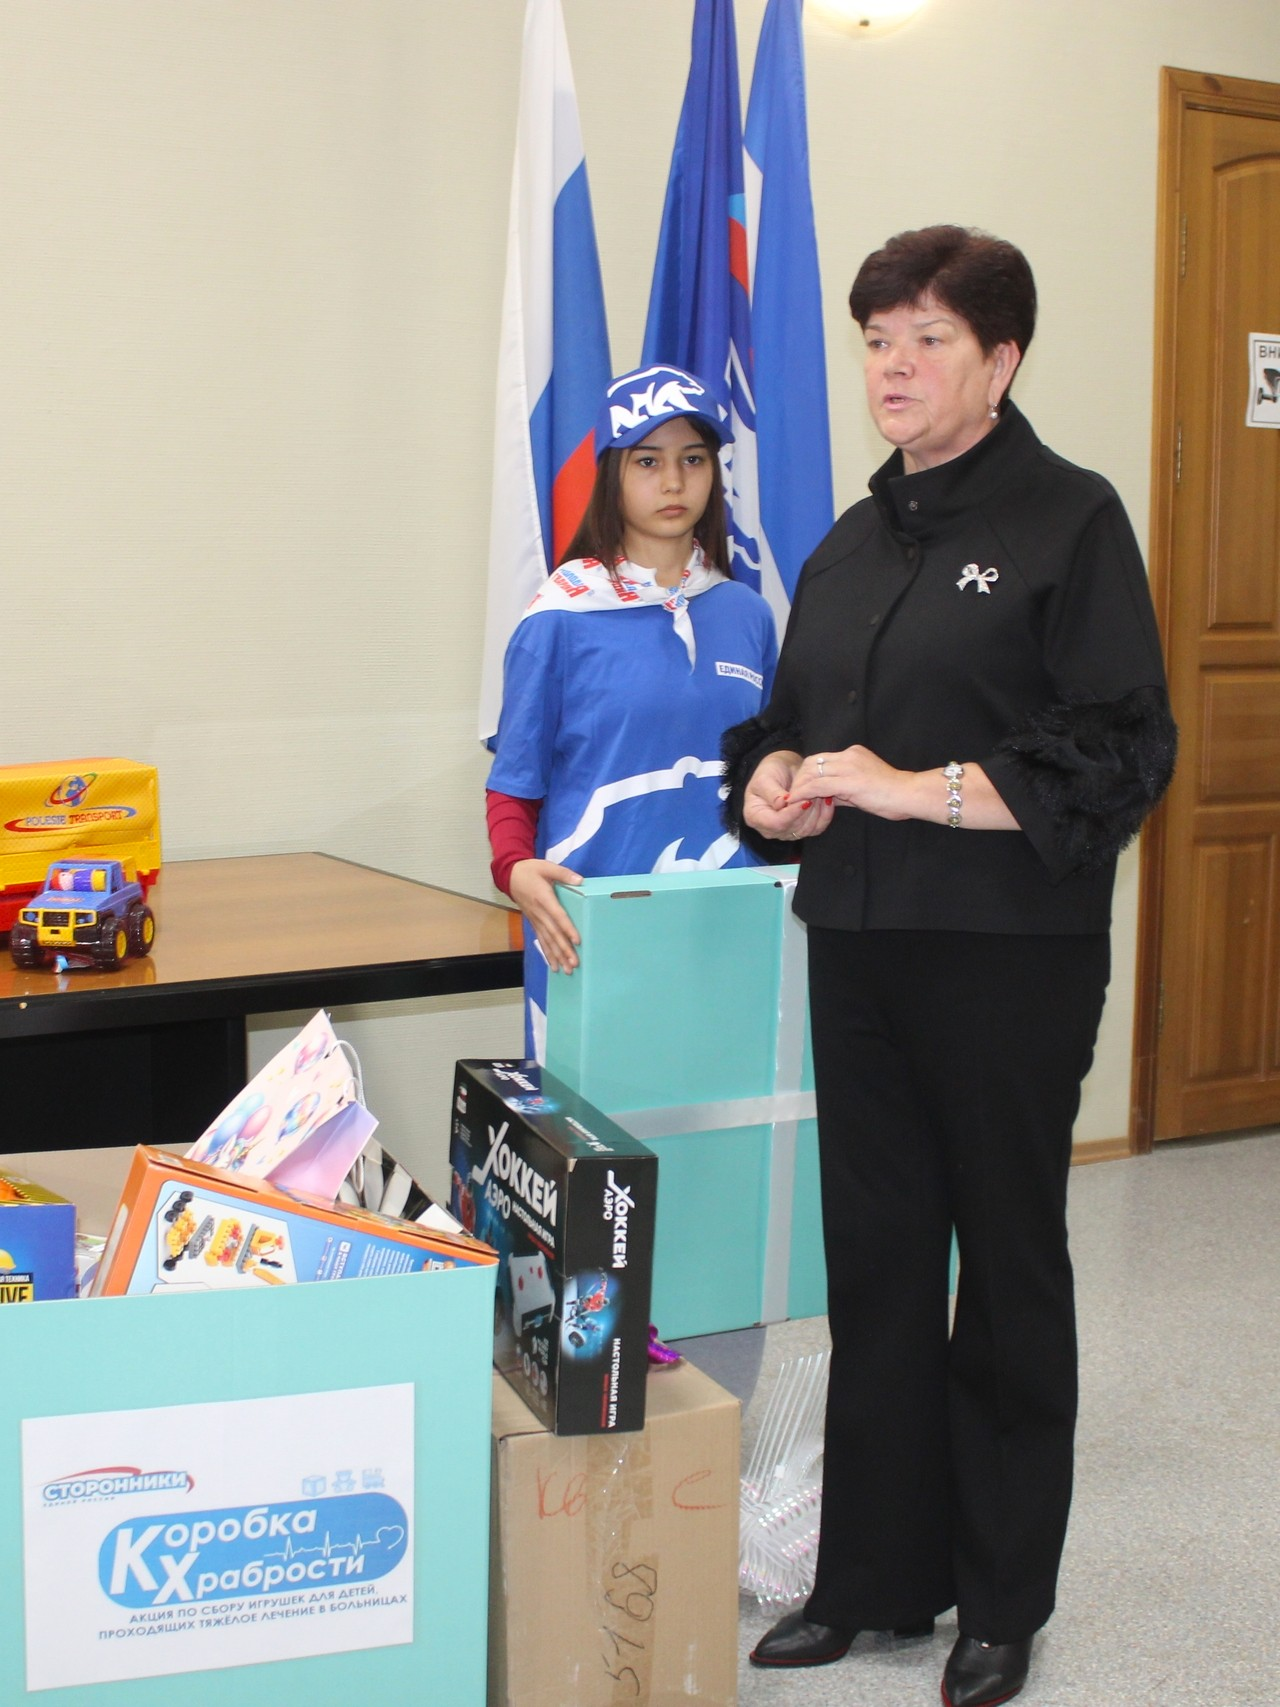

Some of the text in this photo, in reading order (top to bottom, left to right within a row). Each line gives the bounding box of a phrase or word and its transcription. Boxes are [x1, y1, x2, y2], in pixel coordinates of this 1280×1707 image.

[25, 810, 123, 826] POLESIE TRANSPORT
[471, 1121, 558, 1227] ХОККЕЙ
[484, 1179, 511, 1219] АЭРО
[603, 1188, 614, 1220] АЭРО
[607, 1169, 635, 1269] ХОККЕЙ
[608, 1338, 621, 1428] НАСТОЛЬНАЯ ИГРА
[43, 1471, 188, 1501] СТОРОННИКИ
[110, 1507, 318, 1595] Коробка
[152, 1551, 366, 1606] Храбрости
[99, 1620, 195, 1640] ПРОХОДЯЩИХ
[261, 1606, 315, 1621] ЛЕЧЕНИЕ
[319, 1604, 326, 1614] В
[330, 1595, 408, 1612] БОЛЬНИЦАХ
[130, 1610, 174, 1623] АКЦИЯ
[178, 1608, 197, 1618] ПО
[202, 1602, 245, 1615] СБОРУ
[249, 1595, 305, 1610] ИГРУШЕК
[309, 1591, 335, 1603] ДЛЯ
